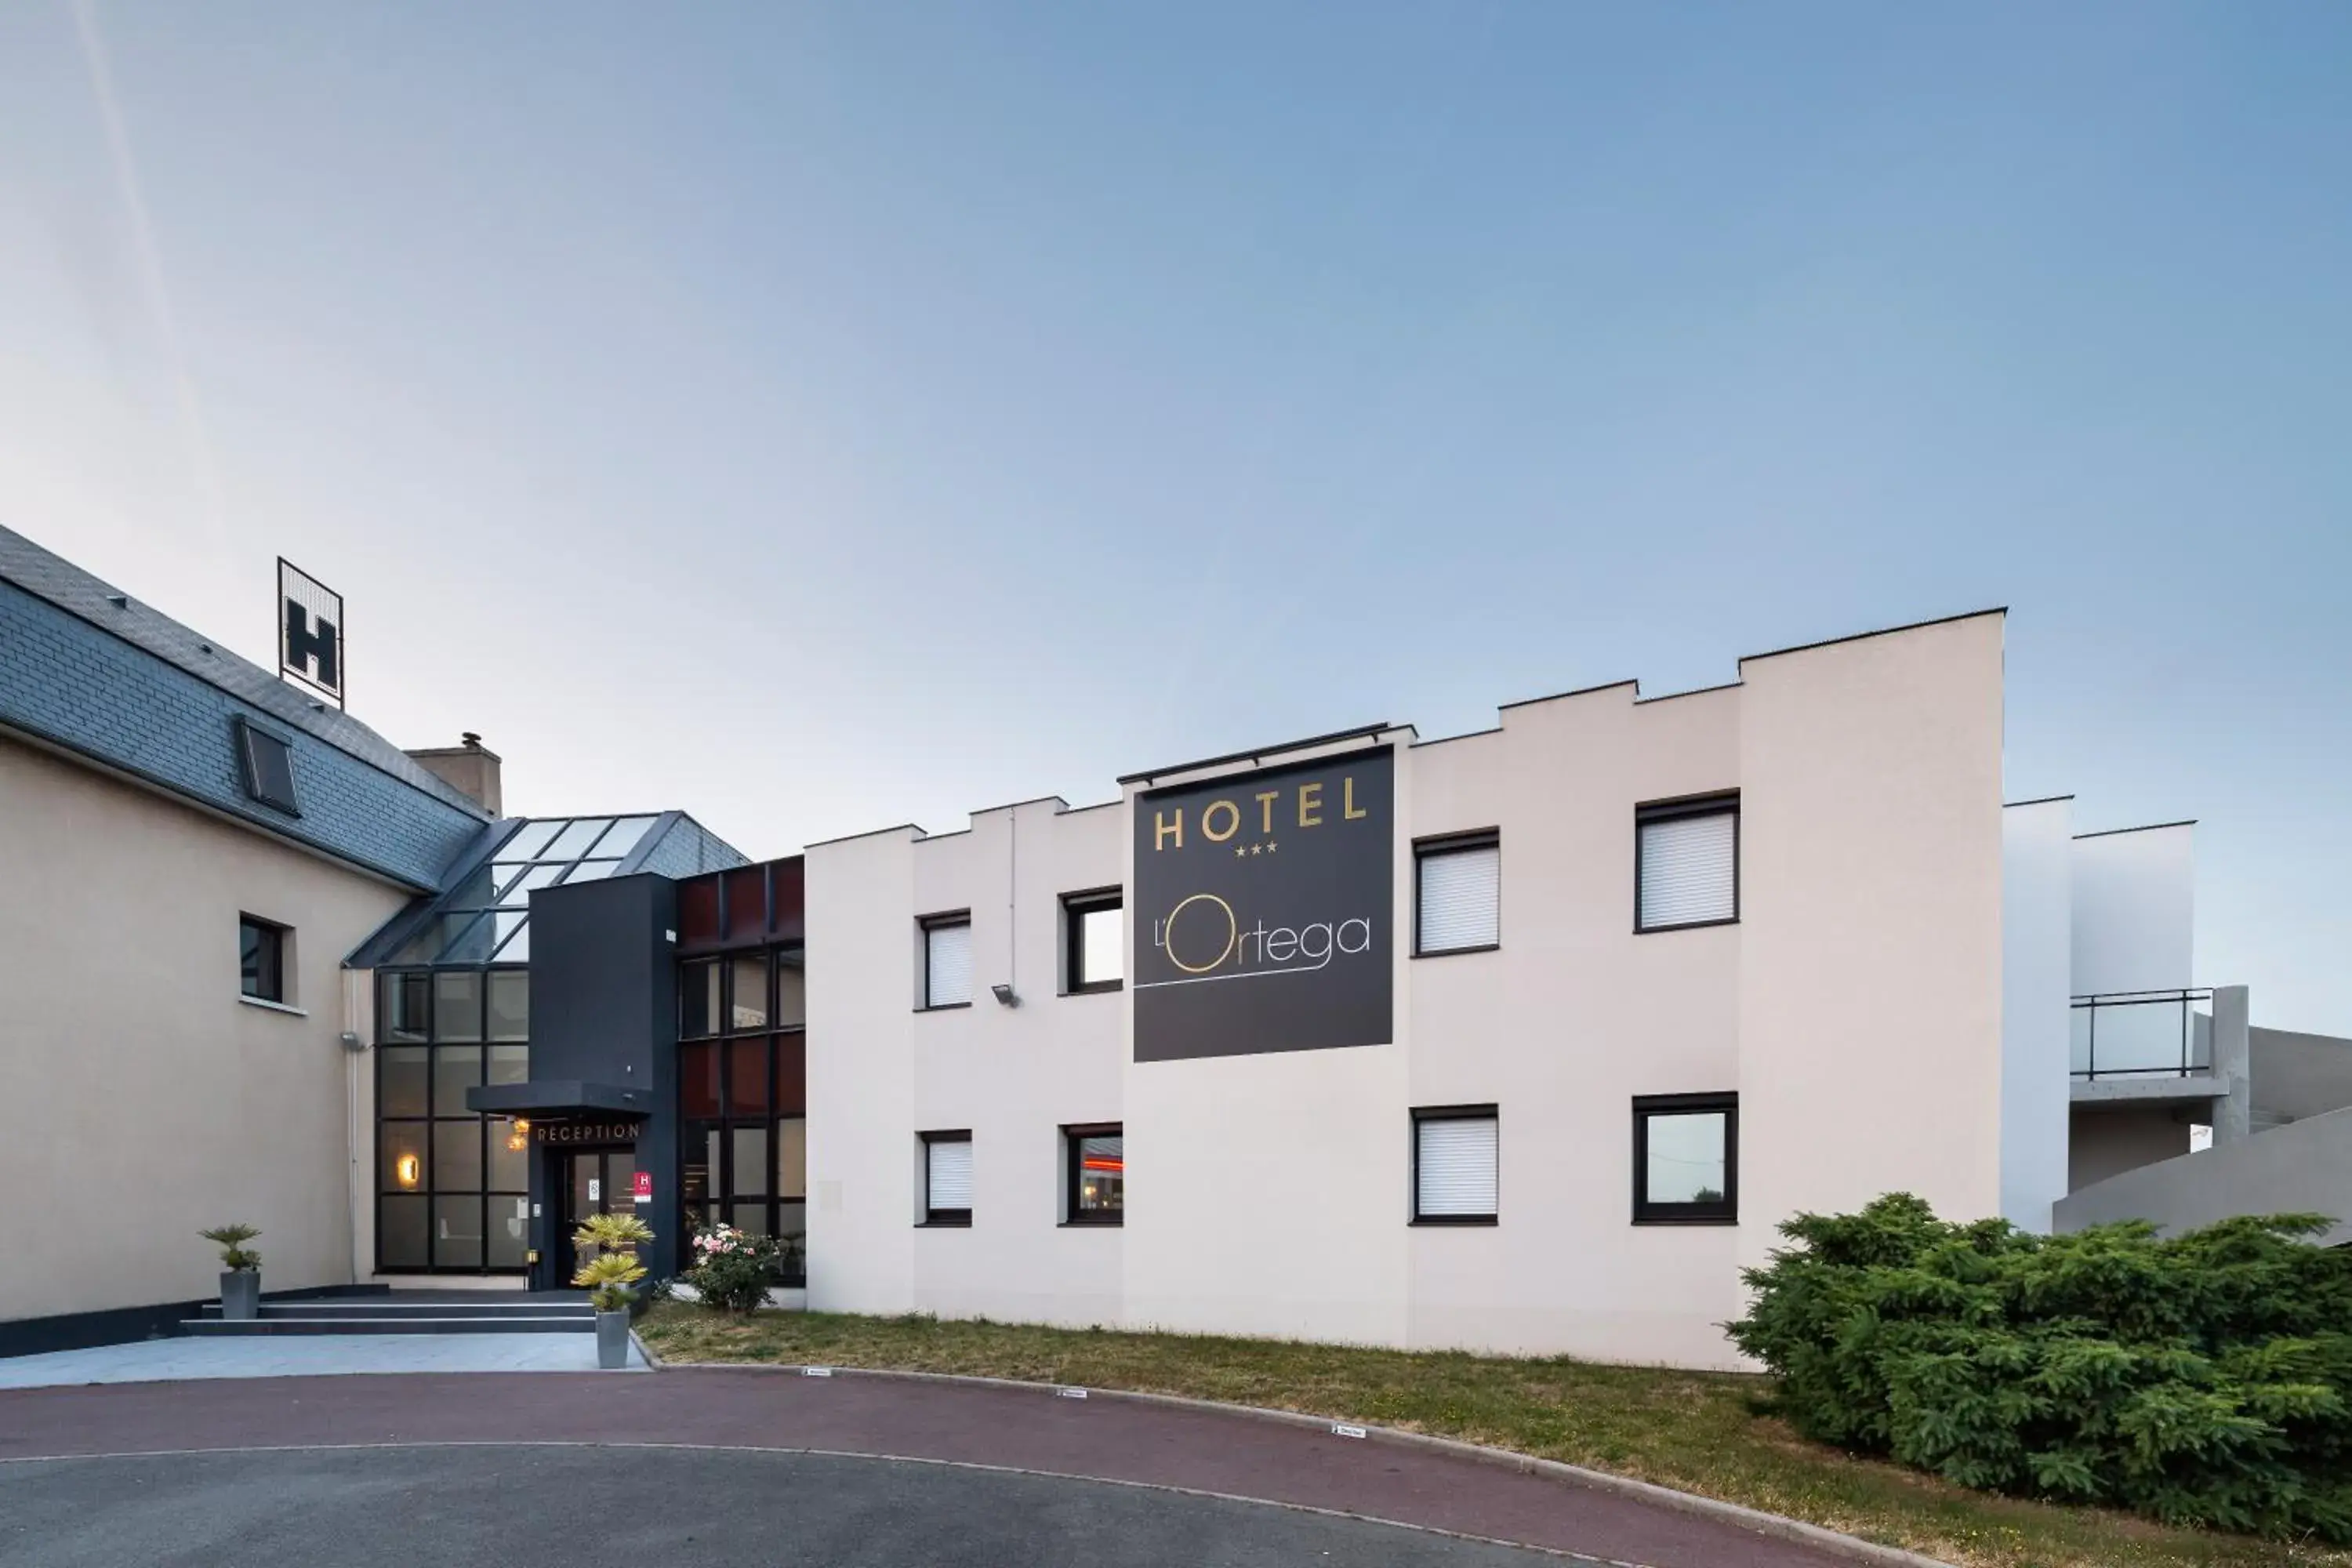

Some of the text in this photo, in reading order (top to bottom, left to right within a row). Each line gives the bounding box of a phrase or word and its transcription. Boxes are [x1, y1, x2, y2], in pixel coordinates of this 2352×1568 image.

[287, 597, 338, 690] H
[1155, 777, 1367, 851] HOTEL
[641, 1175, 648, 1185] H
